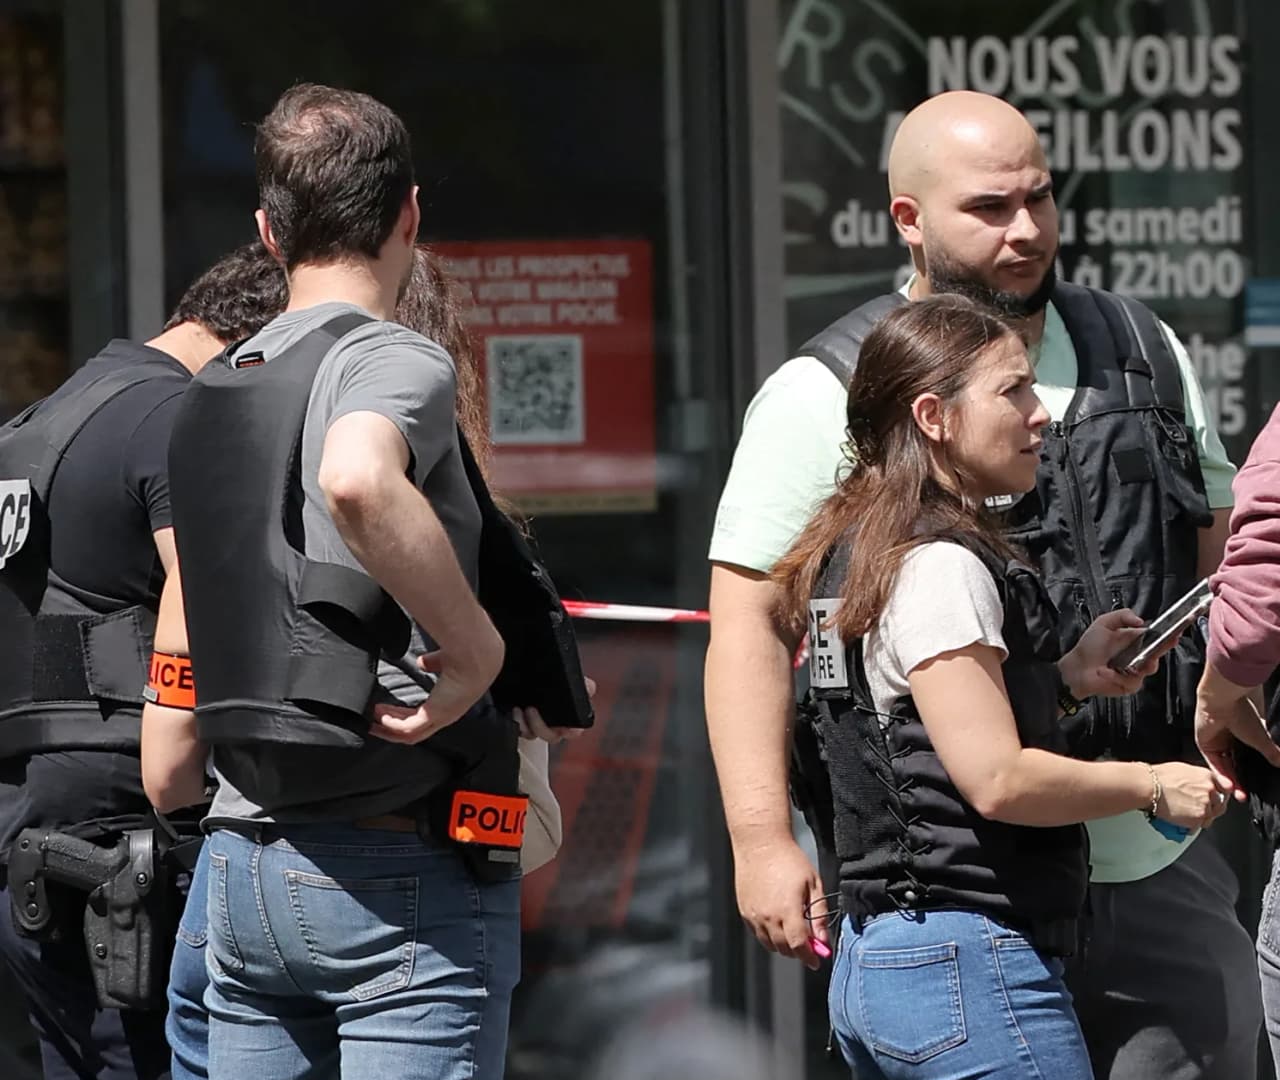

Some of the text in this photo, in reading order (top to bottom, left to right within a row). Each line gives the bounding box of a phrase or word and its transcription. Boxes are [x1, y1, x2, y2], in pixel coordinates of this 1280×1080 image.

[927, 35, 1242, 97] NOUS VOUS
[879, 108, 1243, 171] ILLONS
[831, 200, 888, 247] du
[1085, 196, 1243, 246] samedi
[1111, 249, 1245, 299] 22h00
[150, 662, 193, 690] ICE
[457, 803, 527, 835] POLI
